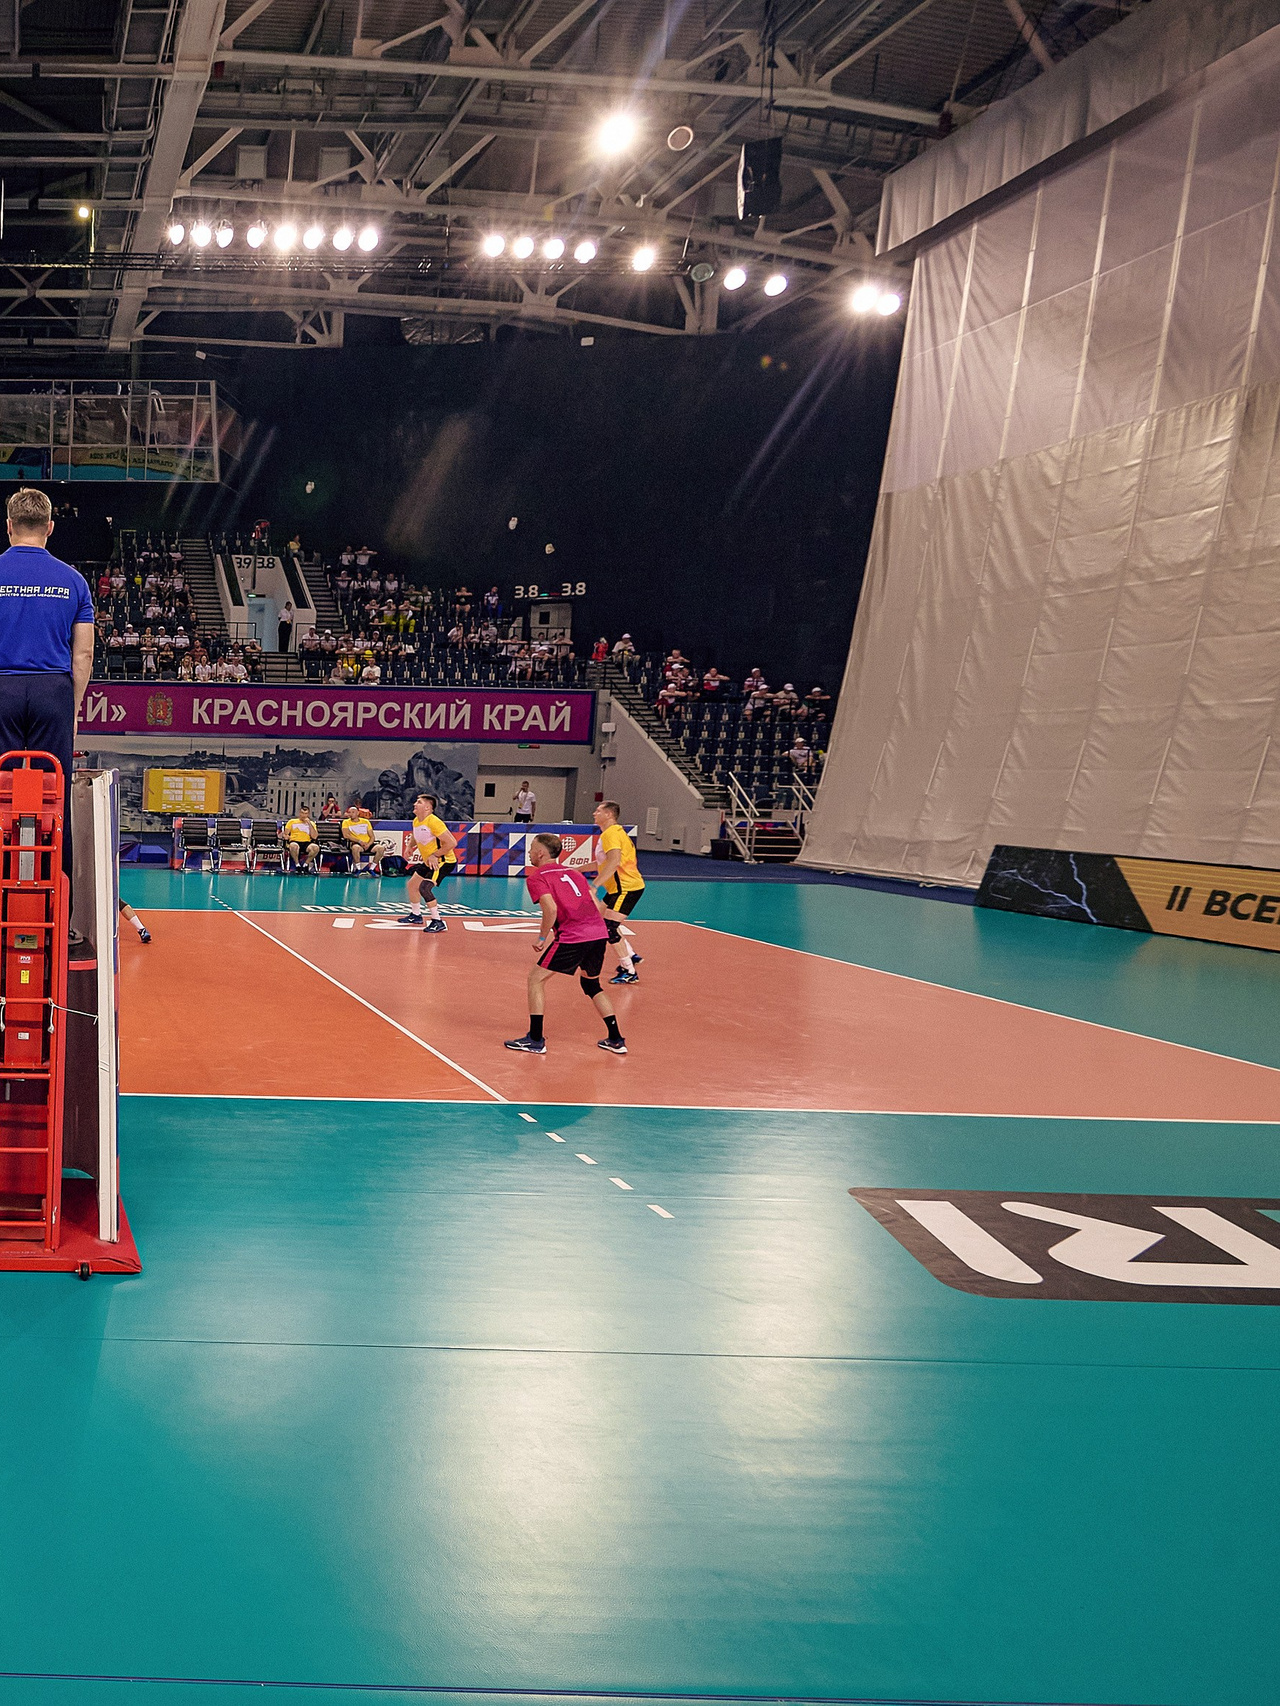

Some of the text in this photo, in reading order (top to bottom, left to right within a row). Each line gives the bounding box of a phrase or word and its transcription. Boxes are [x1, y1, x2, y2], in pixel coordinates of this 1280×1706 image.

[44, 586, 70, 596] ИГРА
[514, 581, 587, 599] 3.8 3.8
[191, 697, 572, 732] КРАСНОЯРСКИЙ КРАЙ
[560, 873, 582, 897] 1
[1202, 889, 1280, 925] ВСЕ
